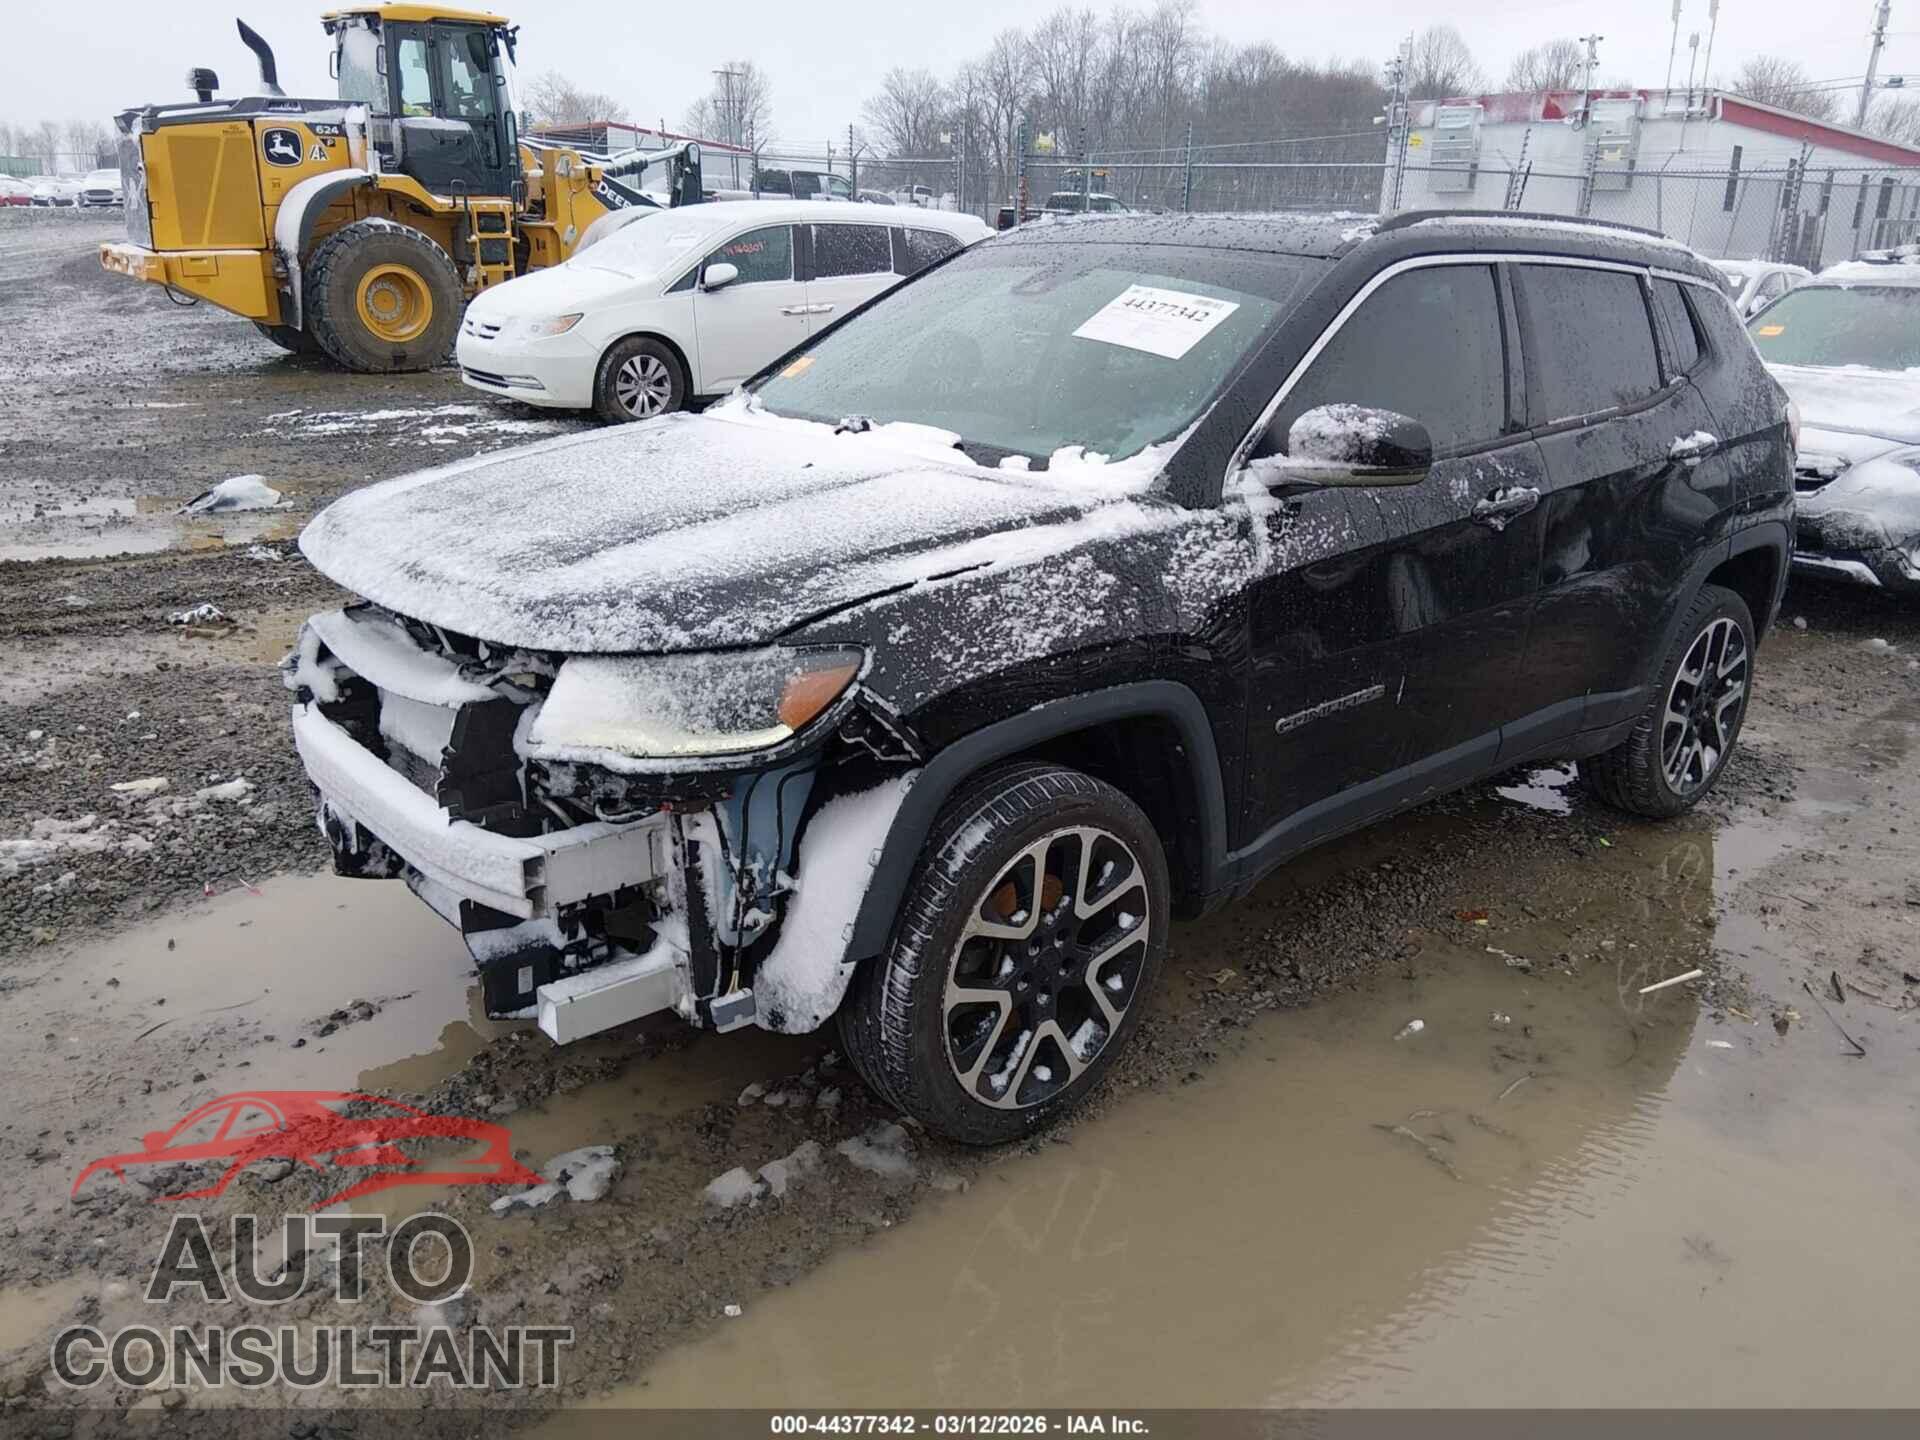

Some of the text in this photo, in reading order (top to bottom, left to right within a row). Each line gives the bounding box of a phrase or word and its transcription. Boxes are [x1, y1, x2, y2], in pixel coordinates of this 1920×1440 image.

[315, 124, 340, 135] 624
[597, 180, 632, 209] DEER
[1121, 297, 1210, 322] 44377342
